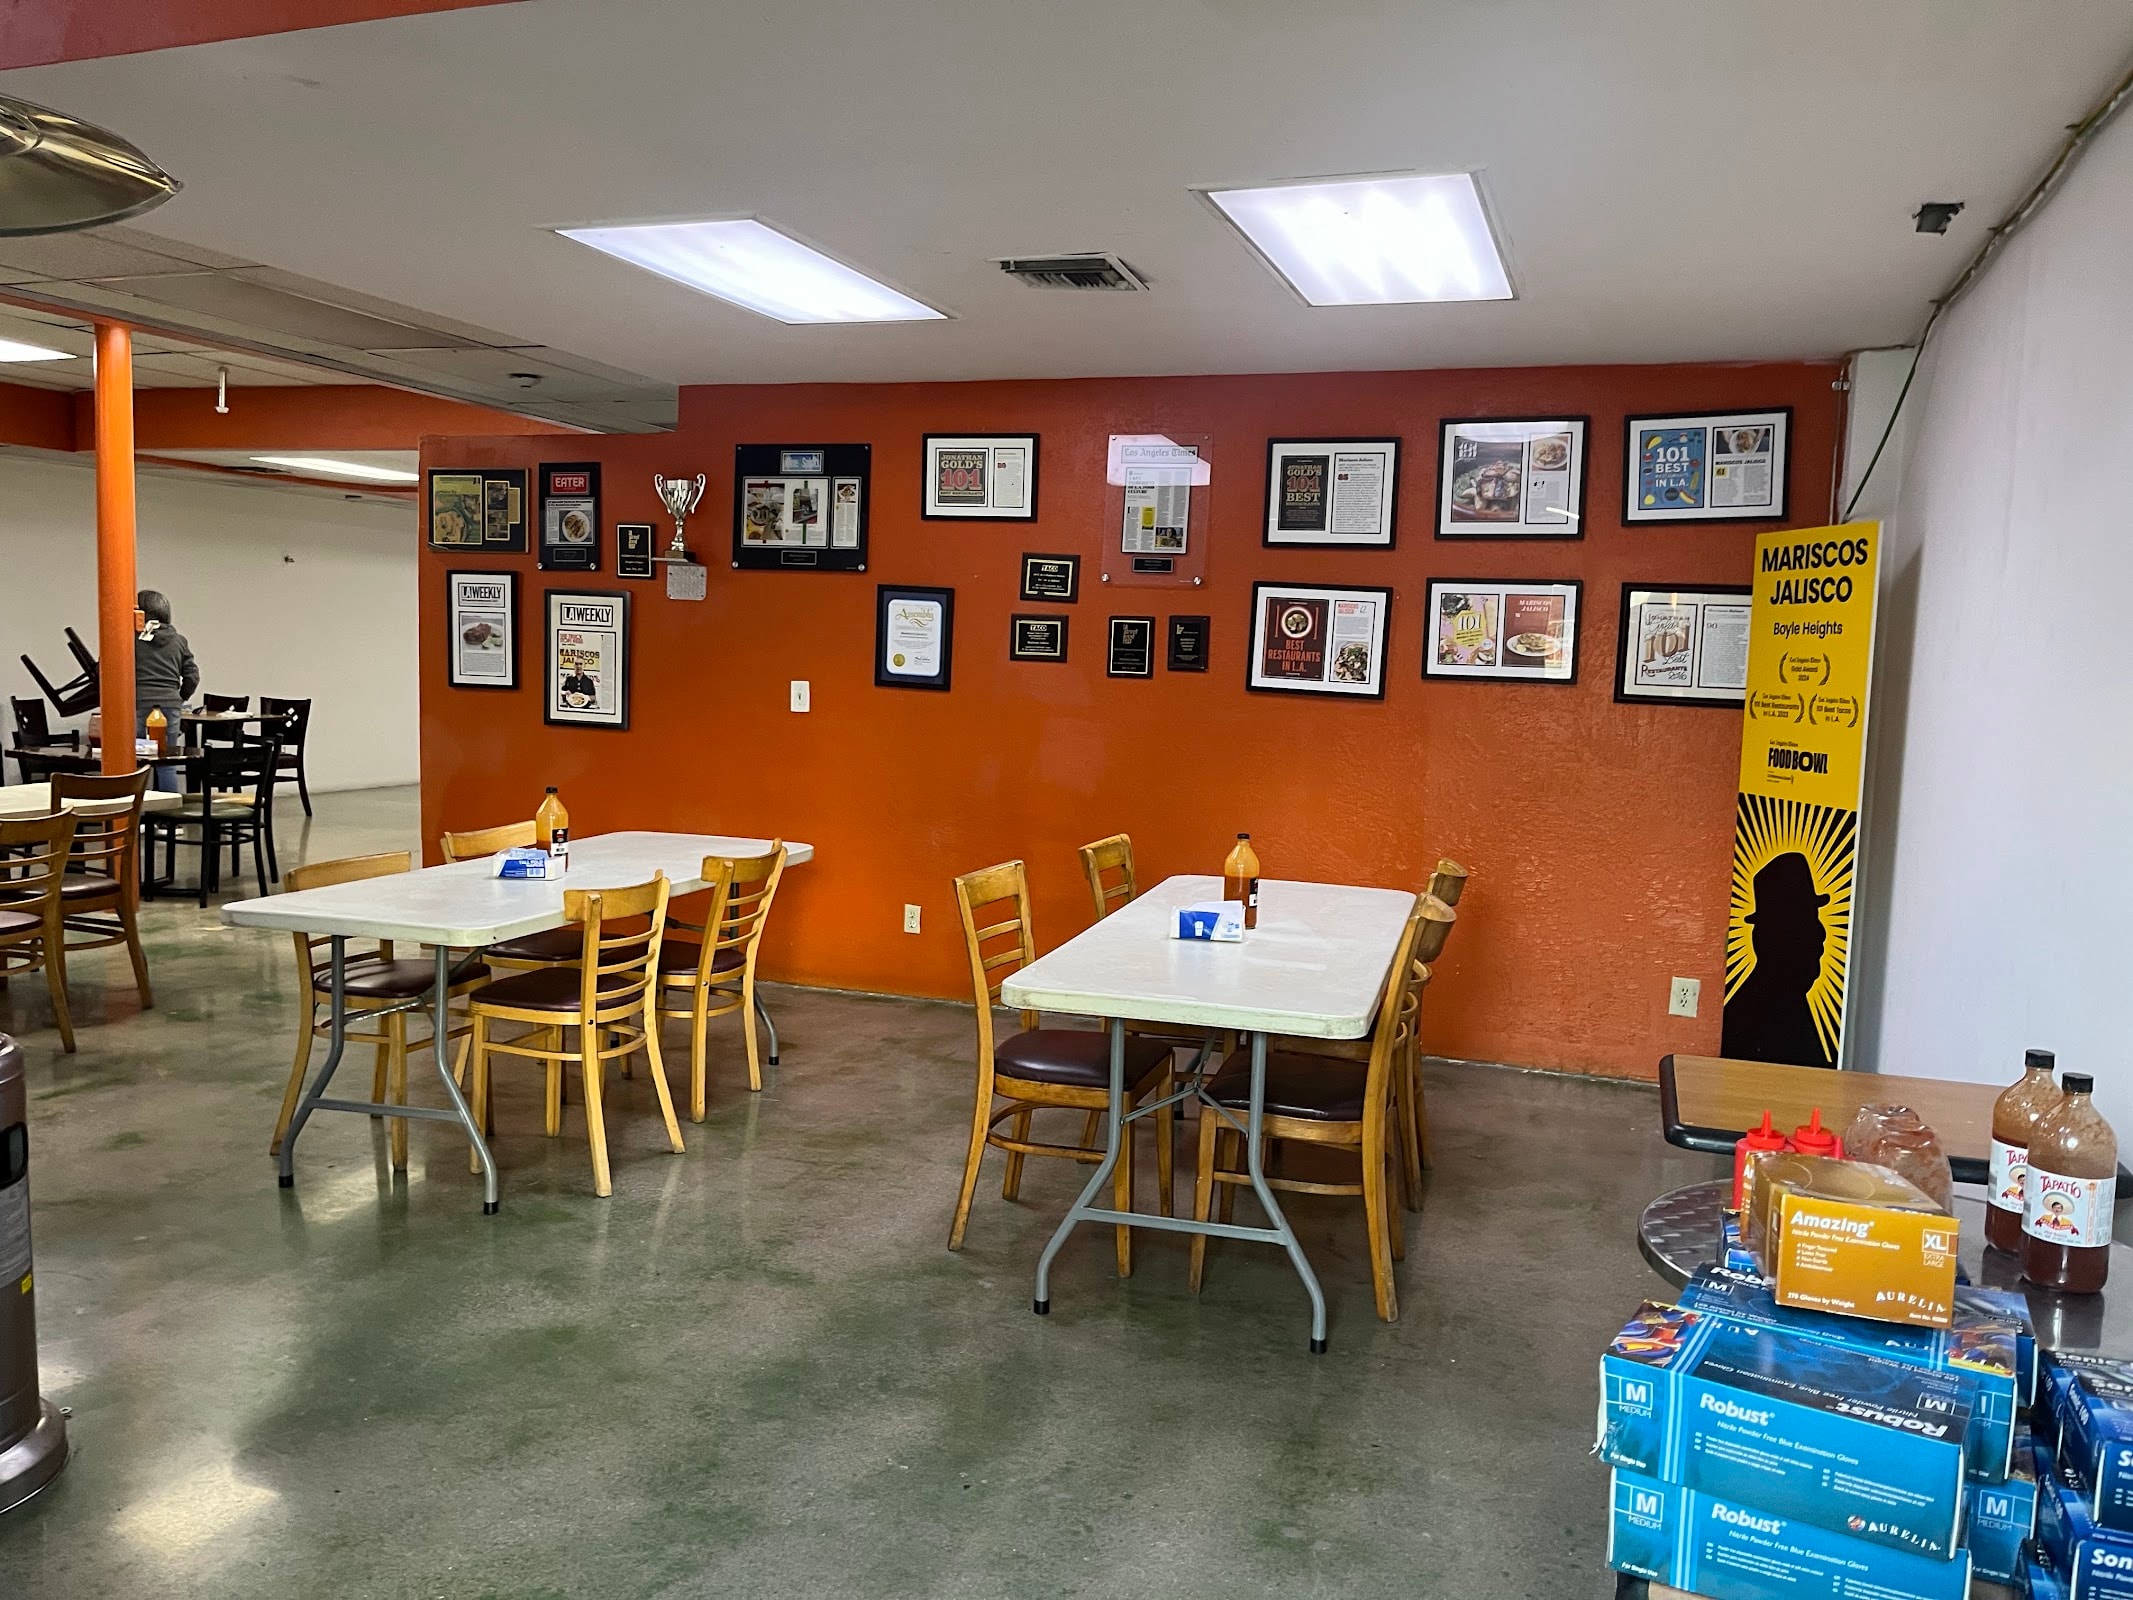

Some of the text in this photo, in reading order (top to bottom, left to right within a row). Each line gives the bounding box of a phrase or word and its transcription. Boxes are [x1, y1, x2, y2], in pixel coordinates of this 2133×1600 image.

[1124, 447, 1196, 457] Los Angeles Times
[1656, 446, 1690, 463] 101
[941, 460, 984, 469] GOLD'S
[1287, 469, 1322, 477] GOLD'S
[1655, 462, 1690, 474] BEST
[555, 477, 585, 488] EATER
[941, 468, 983, 491] 101
[1287, 476, 1321, 493] 101
[1655, 478, 1689, 488] IN L.A.
[1286, 492, 1321, 502] BEST
[1761, 538, 1869, 573] MARISCOS
[1041, 564, 1059, 573] TACO
[472, 586, 502, 599] WEEKLY
[1770, 576, 1853, 605] JALISCO
[574, 606, 611, 623] WEEKLY
[895, 608, 934, 621] Assembly
[1457, 613, 1482, 631] 101
[1030, 624, 1048, 632] TACO
[1773, 620, 1843, 640] Boyle Heights
[1285, 640, 1305, 650] BEST
[1643, 624, 1691, 664] 101
[1267, 649, 1321, 662] RESTAURANTS
[1282, 661, 1307, 673] IN L.A.
[1772, 702, 1800, 710] Restaurants
[2006, 1149, 2029, 1167] TAP
[1790, 1210, 1869, 1238] Amazing
[1924, 1233, 1947, 1251] XL
[1708, 1278, 1728, 1293] M
[1799, 1294, 1856, 1309] Gloves by Weight
[1875, 1291, 1947, 1313] AURELIA
[1625, 1382, 1647, 1404] M
[1703, 1359, 1919, 1418] Nitrile Powder Free Blue Examination Gloves
[1618, 1404, 1652, 1419] MEDIUM
[1699, 1392, 1770, 1427] Robust
[1923, 1398, 1948, 1412] M
[1834, 1402, 1949, 1438] Robust
[1716, 1420, 1859, 1466] Nitrile Powder Free Blue Examination Gloves
[1635, 1492, 1658, 1516] M
[1985, 1495, 2008, 1518] M
[1628, 1514, 1662, 1532] MEDIUM
[1711, 1502, 1782, 1536] Robust
[1867, 1521, 1941, 1551] AURELIA
[1728, 1529, 1869, 1572] Nitrile Powder Free Blue Examination Gloves
[2090, 1548, 2133, 1571] Son
